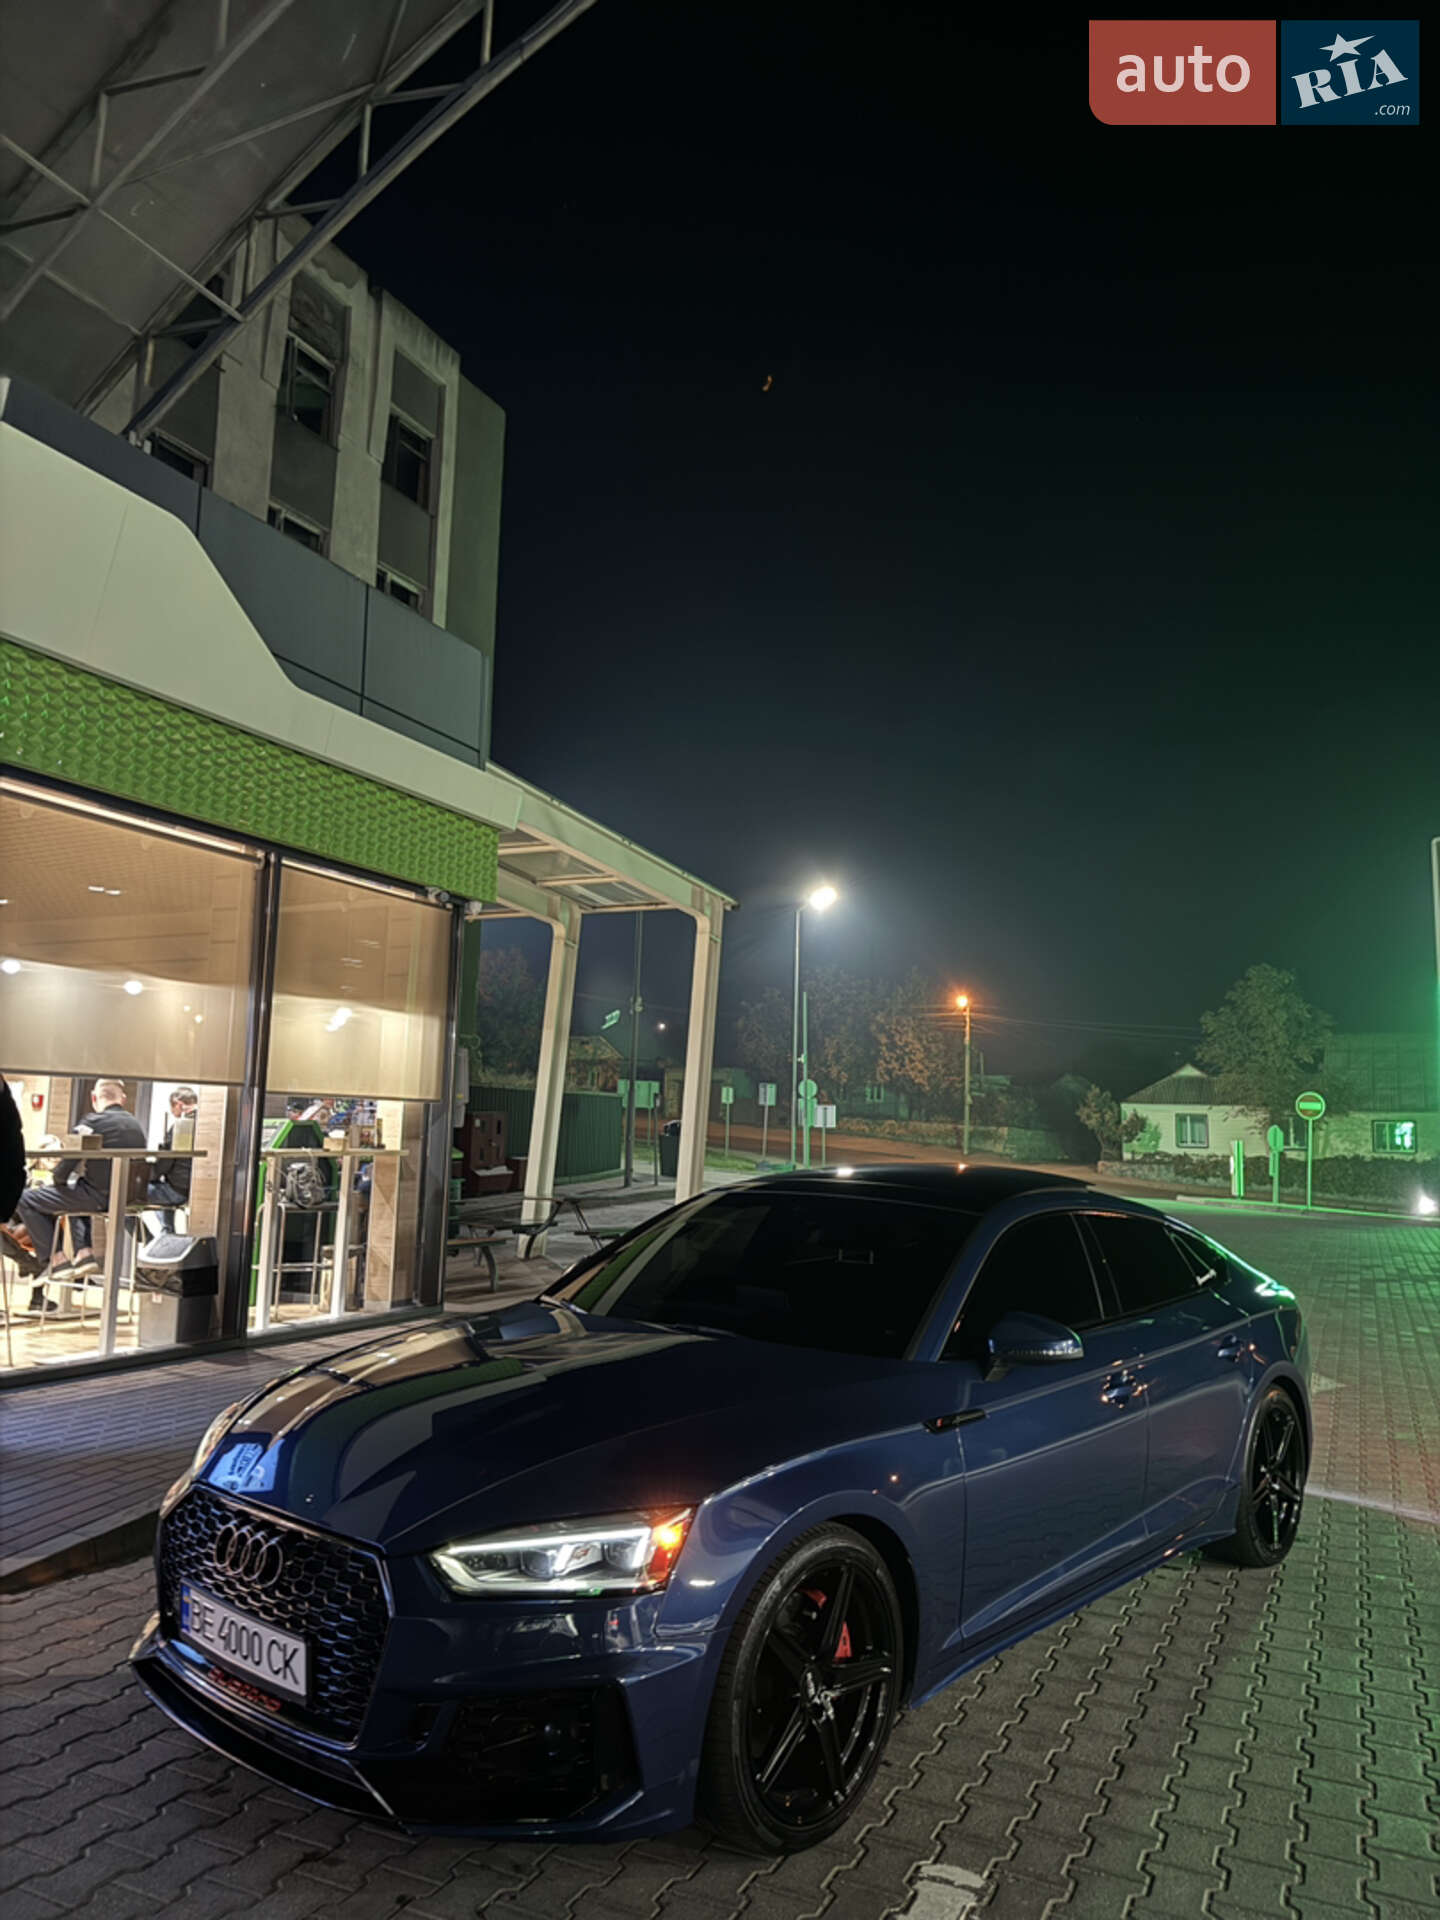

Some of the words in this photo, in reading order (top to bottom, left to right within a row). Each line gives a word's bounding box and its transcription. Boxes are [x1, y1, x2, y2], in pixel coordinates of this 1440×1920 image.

[191, 1598, 215, 1644] BE
[218, 1615, 263, 1668] 4000
[267, 1638, 300, 1686] CK
